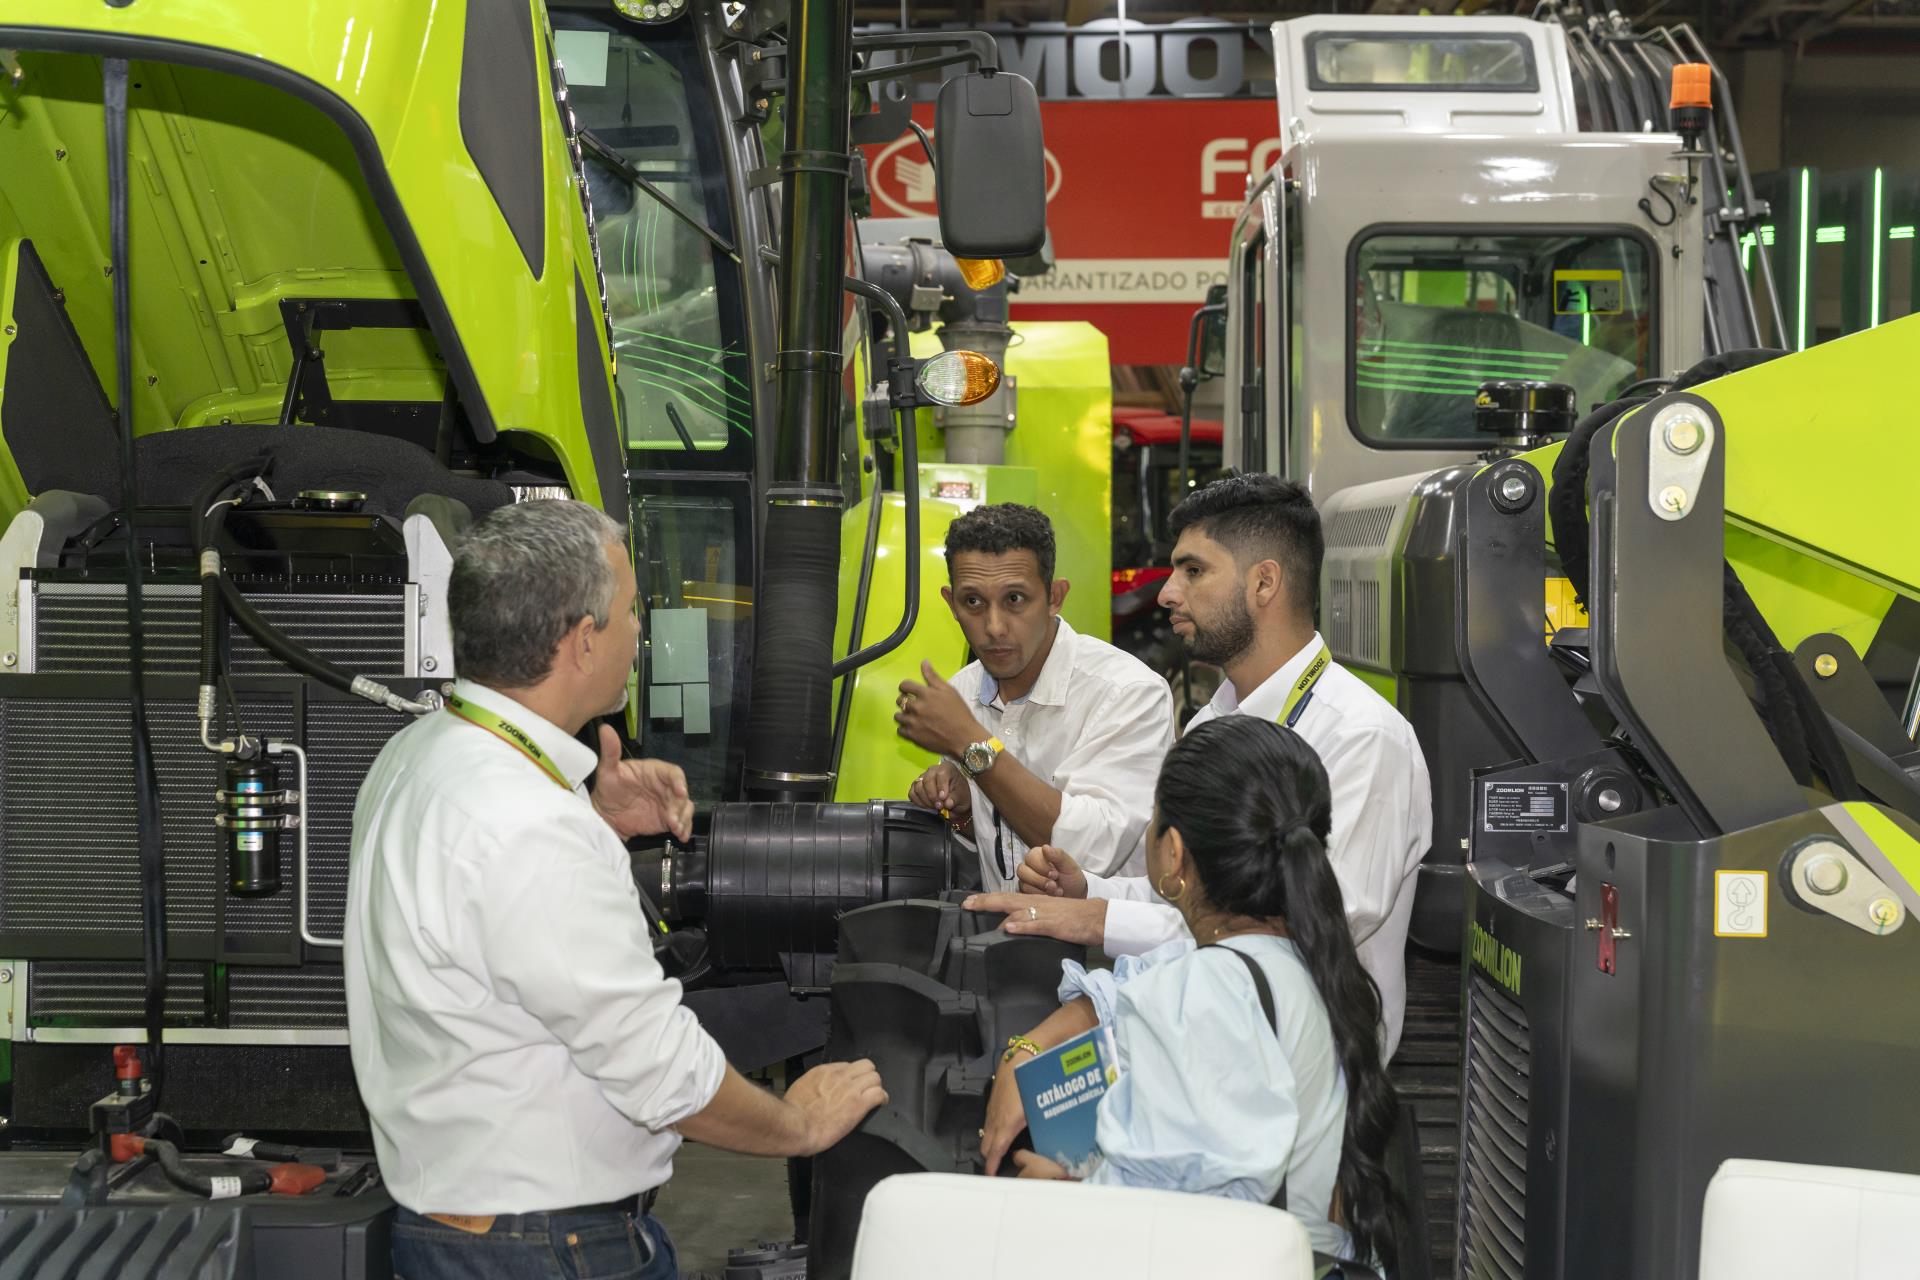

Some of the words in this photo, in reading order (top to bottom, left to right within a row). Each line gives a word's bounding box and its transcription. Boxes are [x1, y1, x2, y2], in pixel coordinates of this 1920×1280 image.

[1018, 271, 1188, 292] ARANTIZADO
[1298, 658, 1325, 691] ZOOMLION
[498, 721, 541, 758] ZOOMLION
[1472, 920, 1521, 995] ZOOMLION
[1037, 1076, 1086, 1108] CATÁLOGO
[1086, 1068, 1102, 1085] DE
